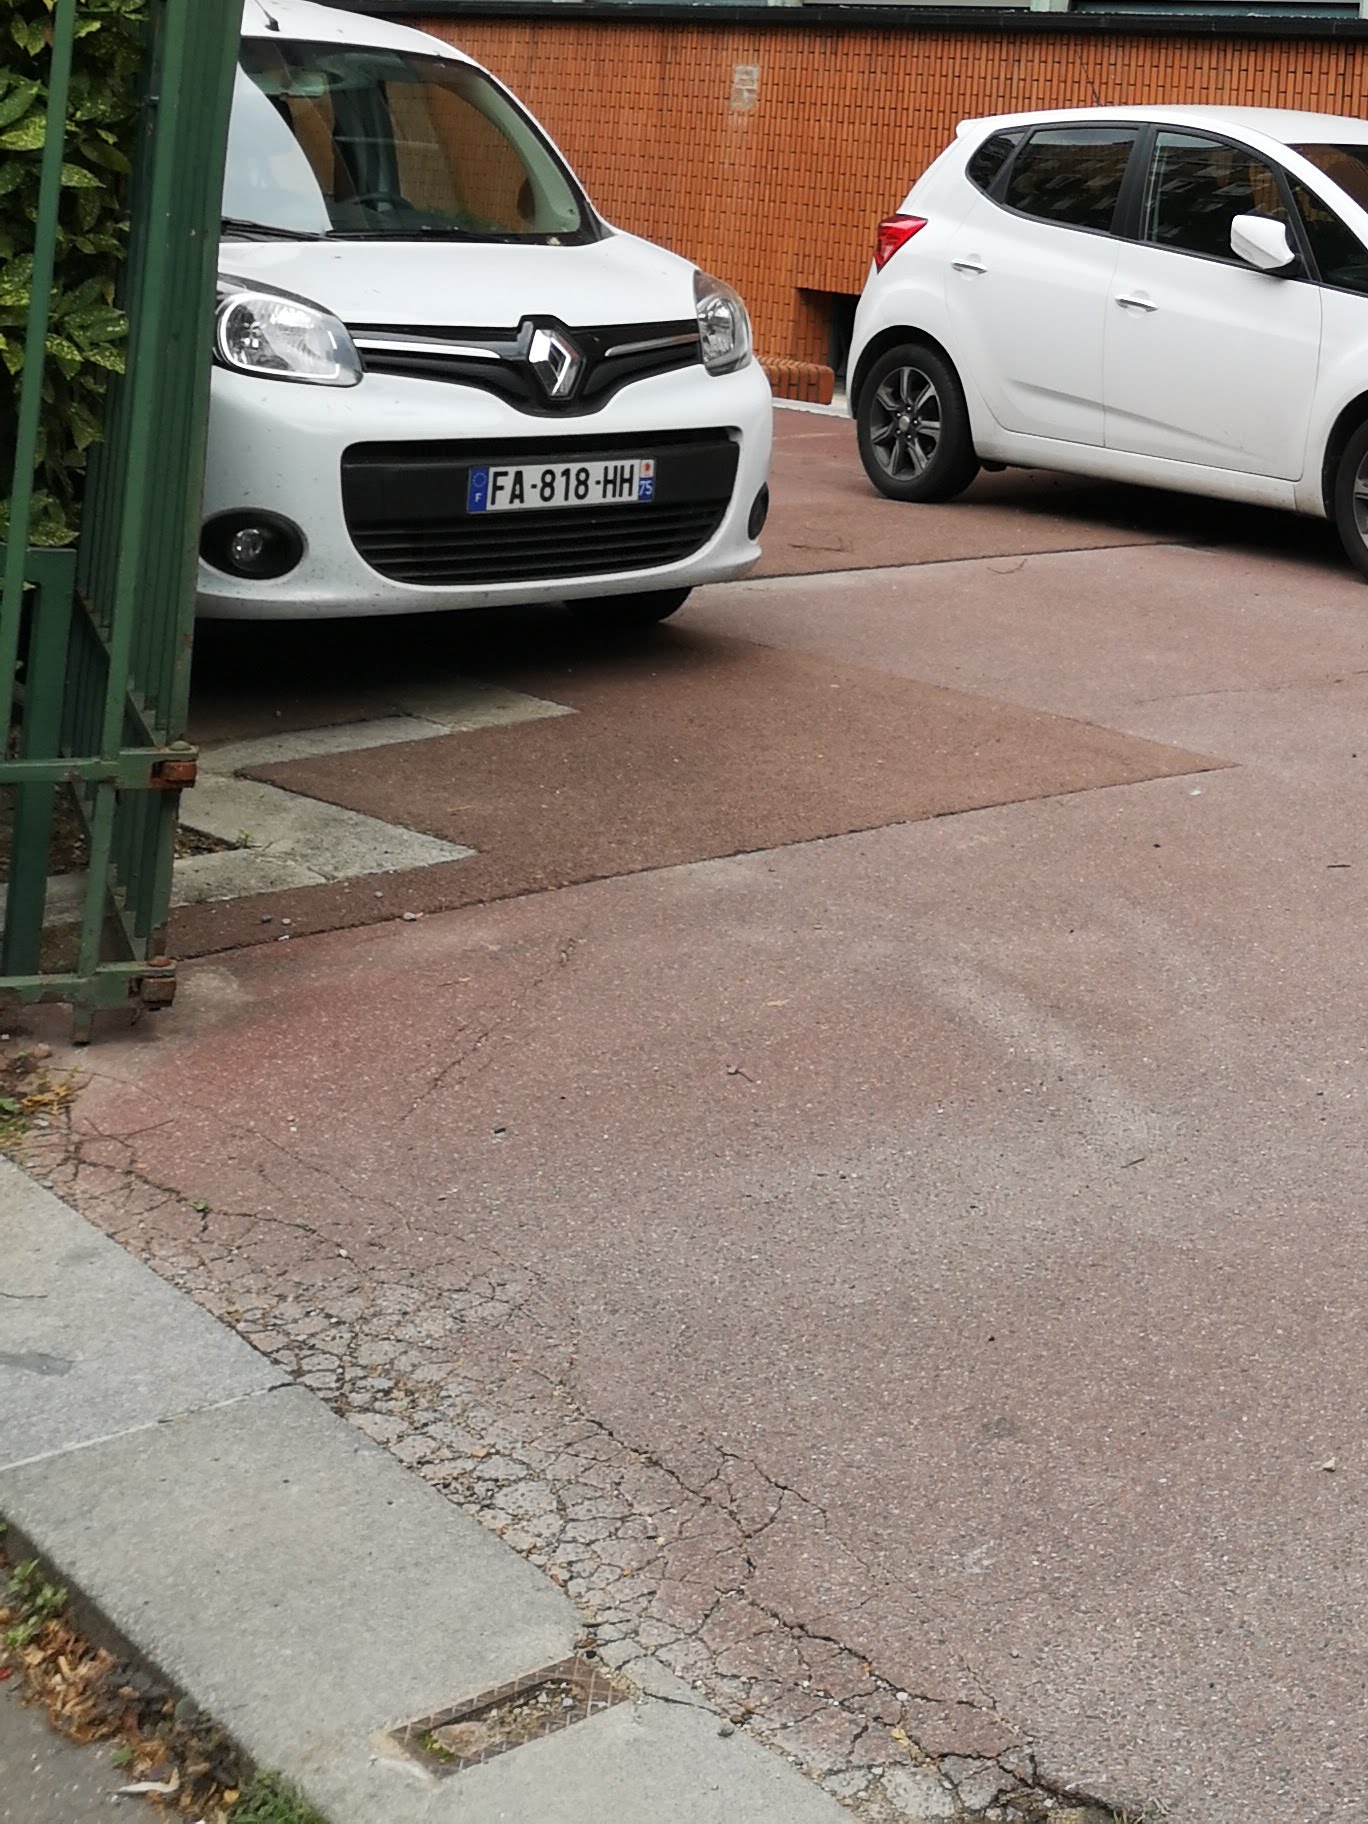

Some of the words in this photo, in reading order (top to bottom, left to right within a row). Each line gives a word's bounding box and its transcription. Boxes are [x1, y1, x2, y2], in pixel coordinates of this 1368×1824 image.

[490, 464, 635, 506] FA-818-HH
[638, 480, 653, 497] 75
[474, 492, 482, 503] F
